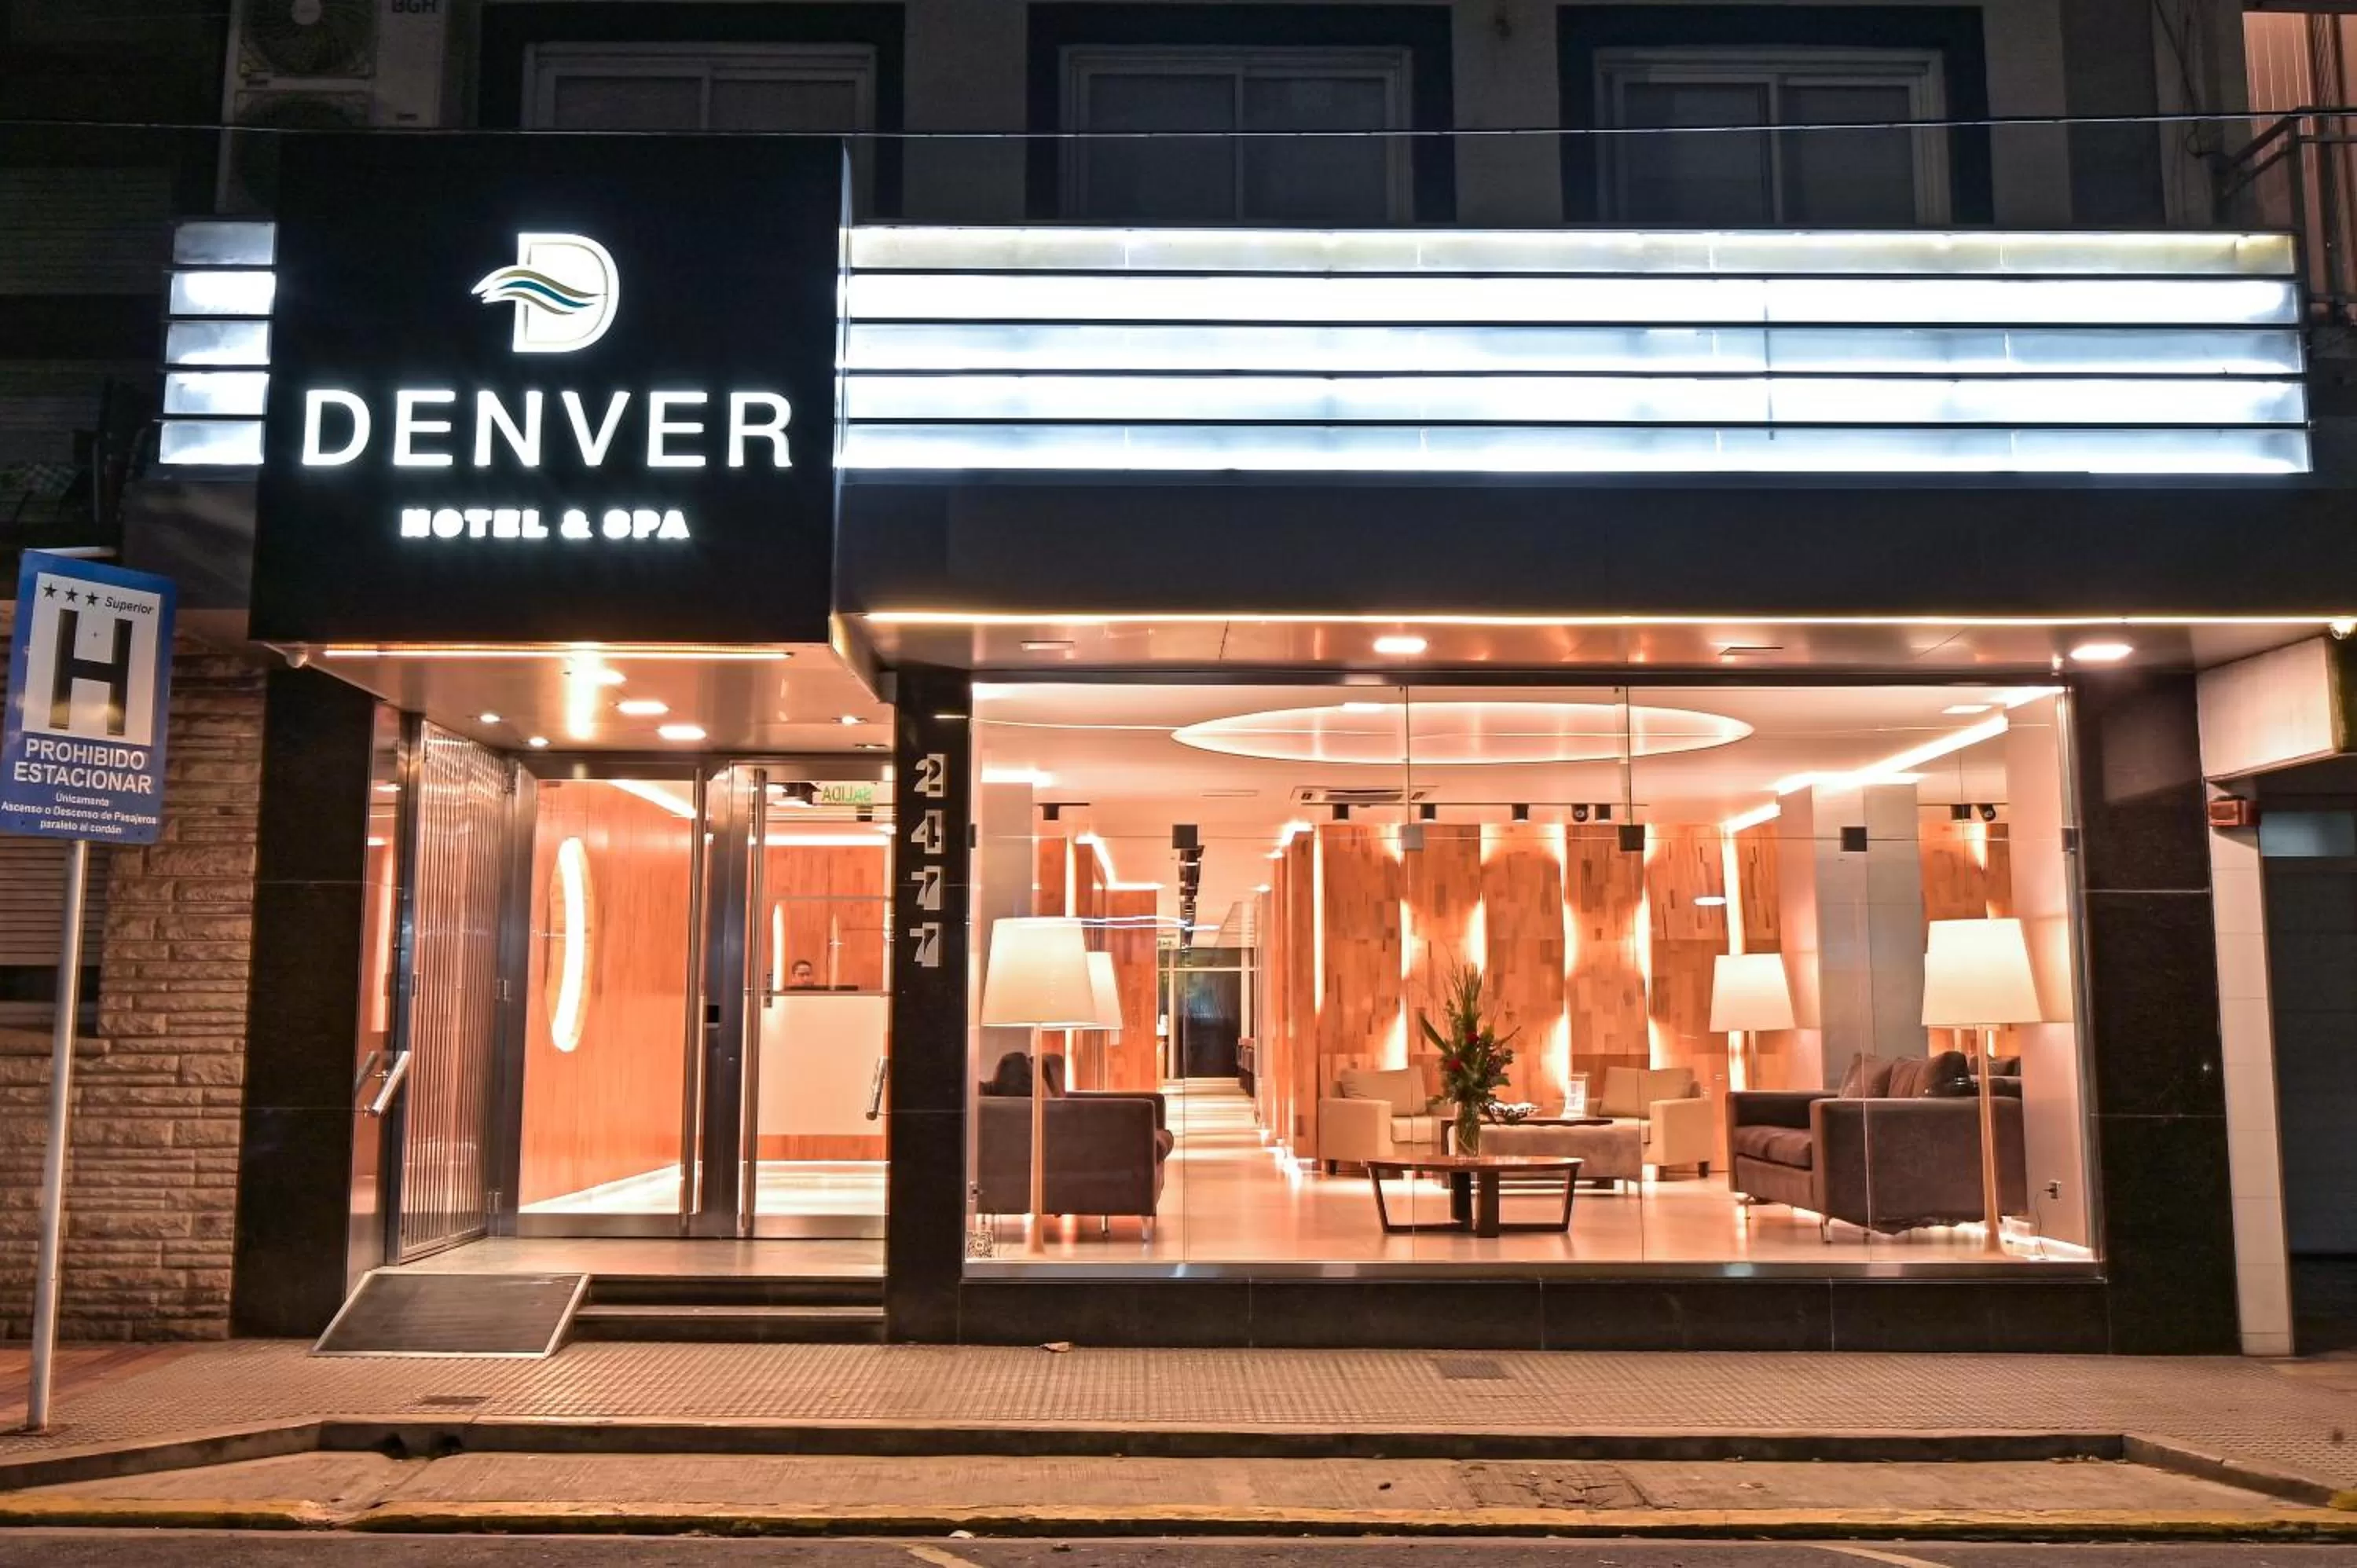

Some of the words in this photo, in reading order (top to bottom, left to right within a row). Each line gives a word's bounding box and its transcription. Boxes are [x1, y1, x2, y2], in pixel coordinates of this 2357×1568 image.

[302, 390, 793, 468] DENVER
[401, 509, 548, 539] HOTEL
[560, 510, 592, 539] &
[603, 510, 691, 540] SPA
[104, 596, 153, 615] Superior
[49, 608, 133, 736] H
[25, 738, 145, 770] PROHIBIDO
[13, 761, 152, 794] ESTACIONAR
[1, 800, 42, 815] Ascenso
[53, 805, 98, 819] Descenso
[114, 811, 156, 825] Pasajeros
[40, 819, 78, 831] paralelo
